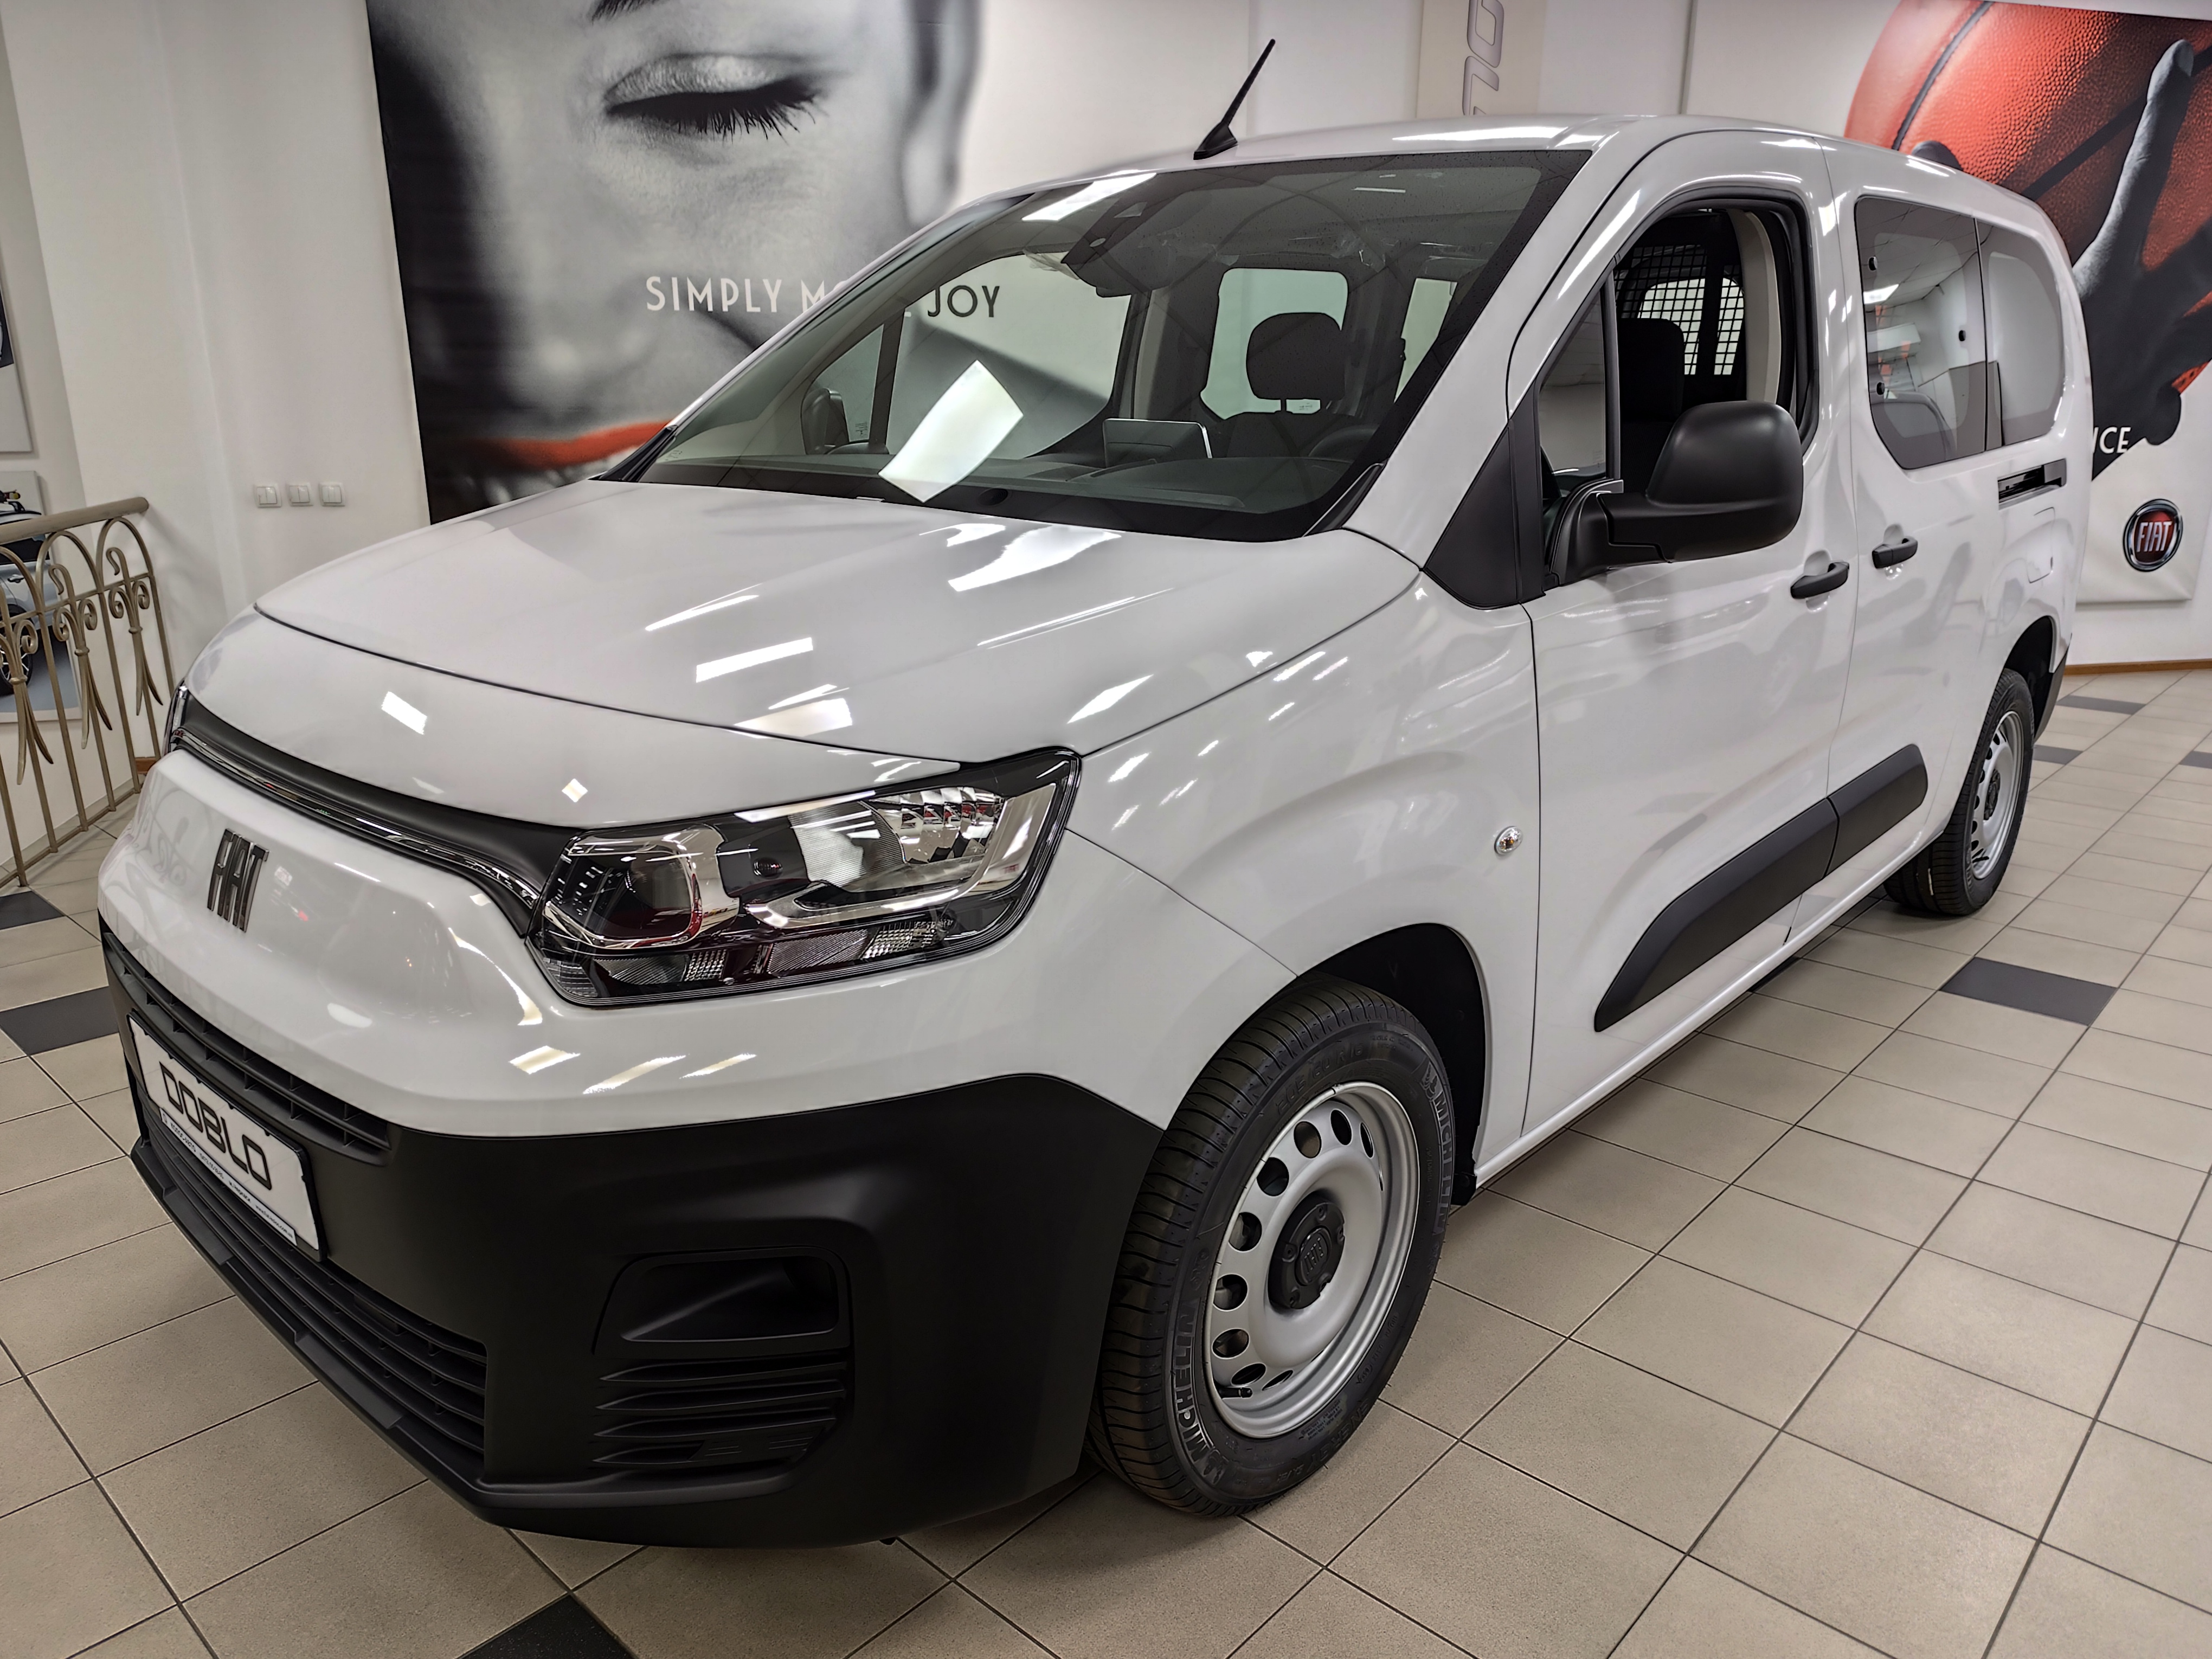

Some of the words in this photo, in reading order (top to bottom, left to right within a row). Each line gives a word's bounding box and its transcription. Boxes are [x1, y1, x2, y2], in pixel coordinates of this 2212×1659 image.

[646, 275, 782, 313] SIMPLY
[928, 285, 1000, 318] JOY
[2137, 520, 2172, 553] FIAT
[207, 828, 269, 933] FIAT
[159, 1061, 272, 1190] DOBLO
[1432, 1091, 1452, 1230] MICHELIN
[1175, 1303, 1210, 1462] MICHELIN
